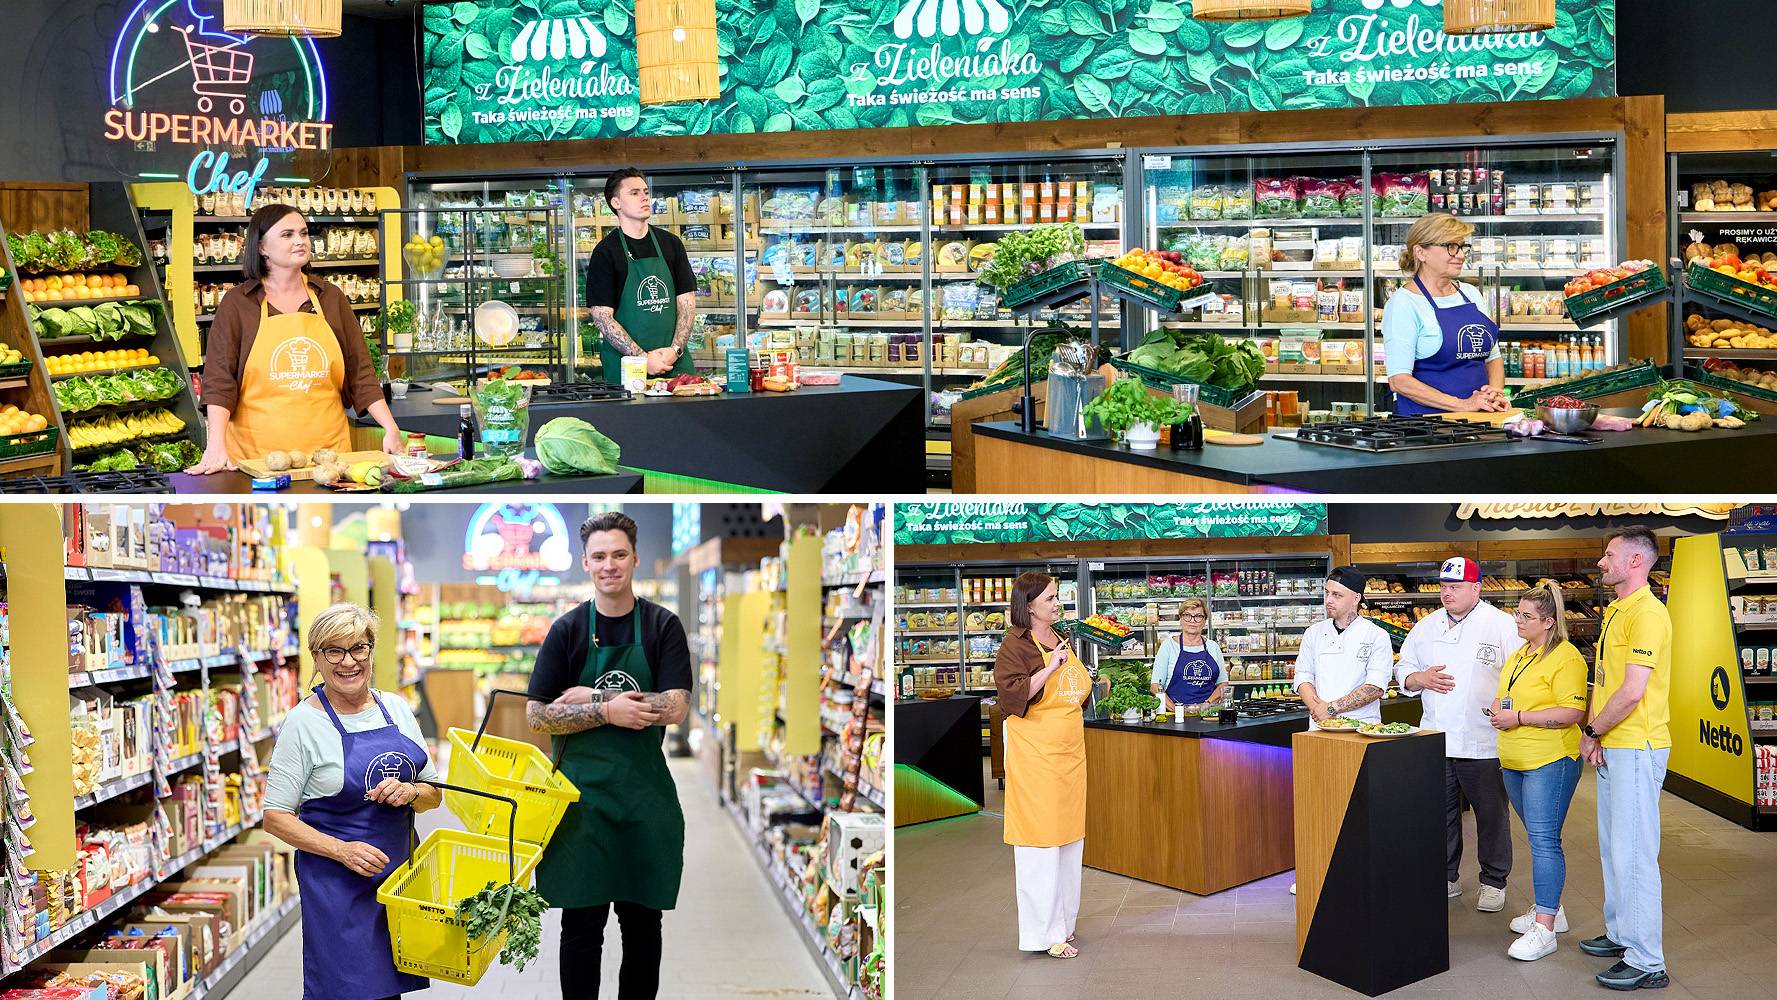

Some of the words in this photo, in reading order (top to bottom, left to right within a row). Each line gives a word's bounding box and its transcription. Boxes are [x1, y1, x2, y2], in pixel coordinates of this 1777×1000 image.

[874, 38, 1043, 87] Zieleniaka
[1303, 70, 1350, 86] Taka
[1356, 60, 1451, 83] świeżość
[1456, 64, 1487, 78] ma
[1493, 61, 1543, 77] sens
[495, 61, 634, 106] Zieleniaka
[847, 93, 886, 107] Taka
[889, 86, 967, 106] świeżość
[970, 88, 997, 101] ma
[1001, 86, 1041, 100] sens
[472, 110, 505, 125] Taka
[508, 104, 573, 122] świeżość
[575, 107, 598, 119] ma
[600, 105, 634, 119] sens
[104, 109, 333, 151] SUPERMARKET
[187, 149, 269, 209] Chef
[1764, 227, 1777, 236] UŻ
[269, 370, 330, 380] SUPERMARKET
[289, 380, 312, 393] Chef
[906, 522, 932, 532] Taka
[934, 520, 983, 531] świeżość
[985, 522, 1001, 530] ma
[1003, 521, 1028, 530] sens
[1173, 516, 1199, 526] Taka
[1251, 515, 1268, 524] ma
[1699, 719, 1743, 756] Netto
